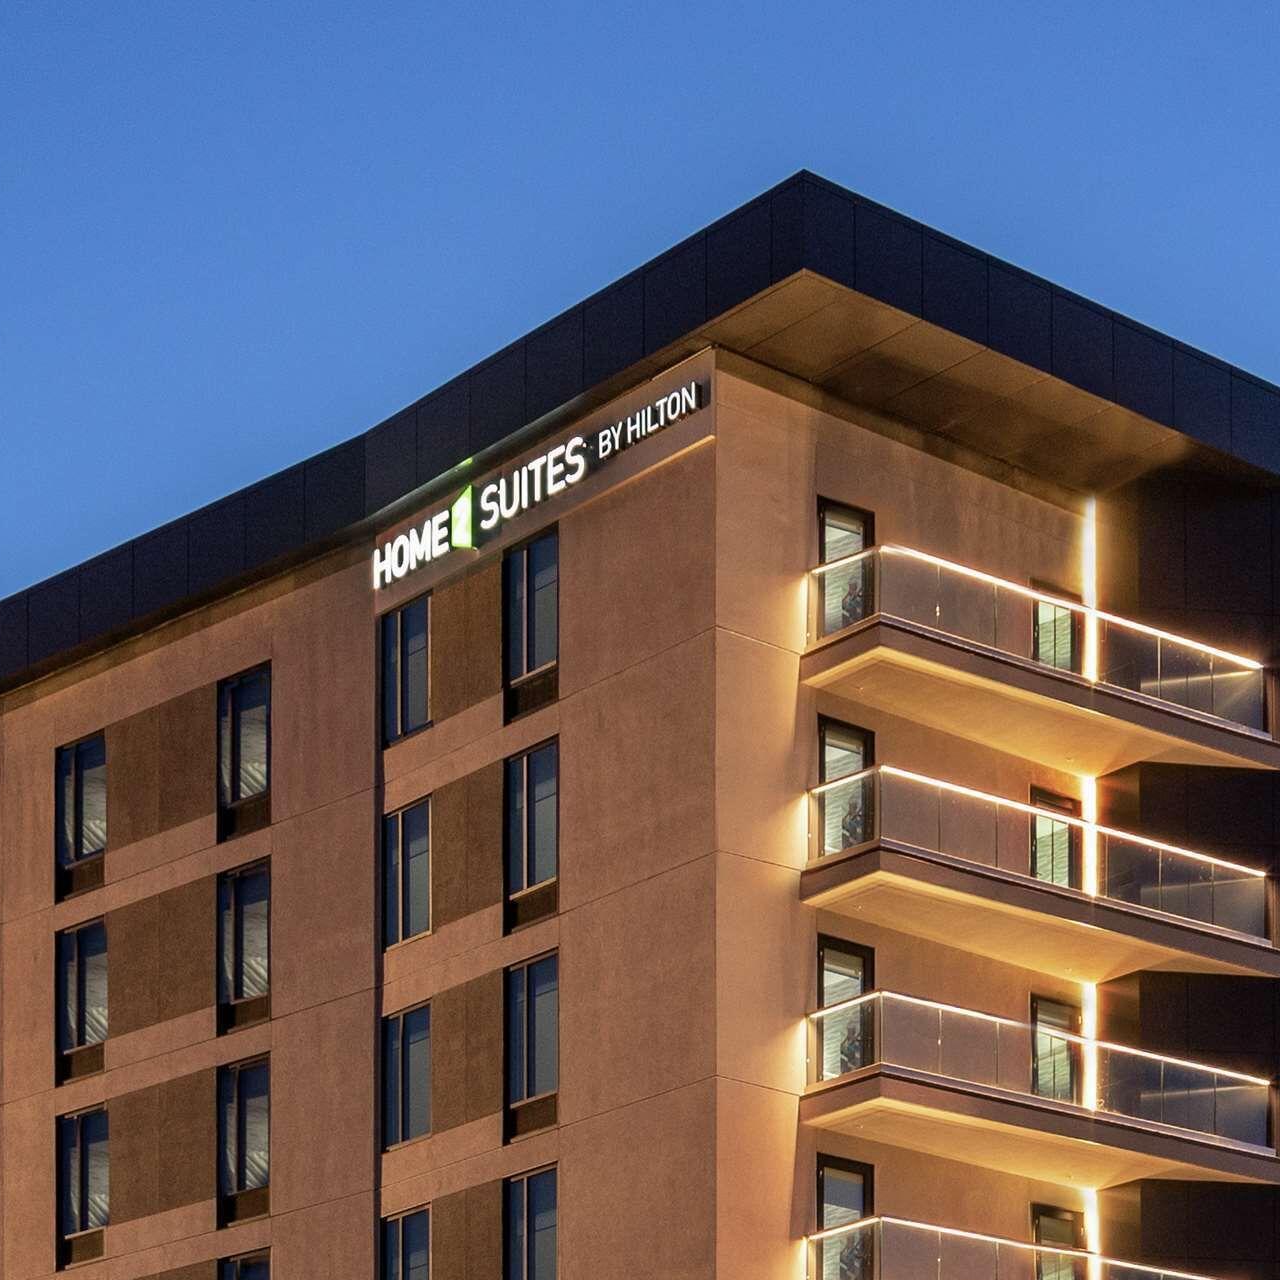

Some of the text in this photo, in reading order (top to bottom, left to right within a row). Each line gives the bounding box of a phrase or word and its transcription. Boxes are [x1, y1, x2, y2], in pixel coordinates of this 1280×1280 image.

[480, 437, 587, 531] SUITES
[598, 421, 624, 460] BY
[627, 381, 697, 445] HILTON
